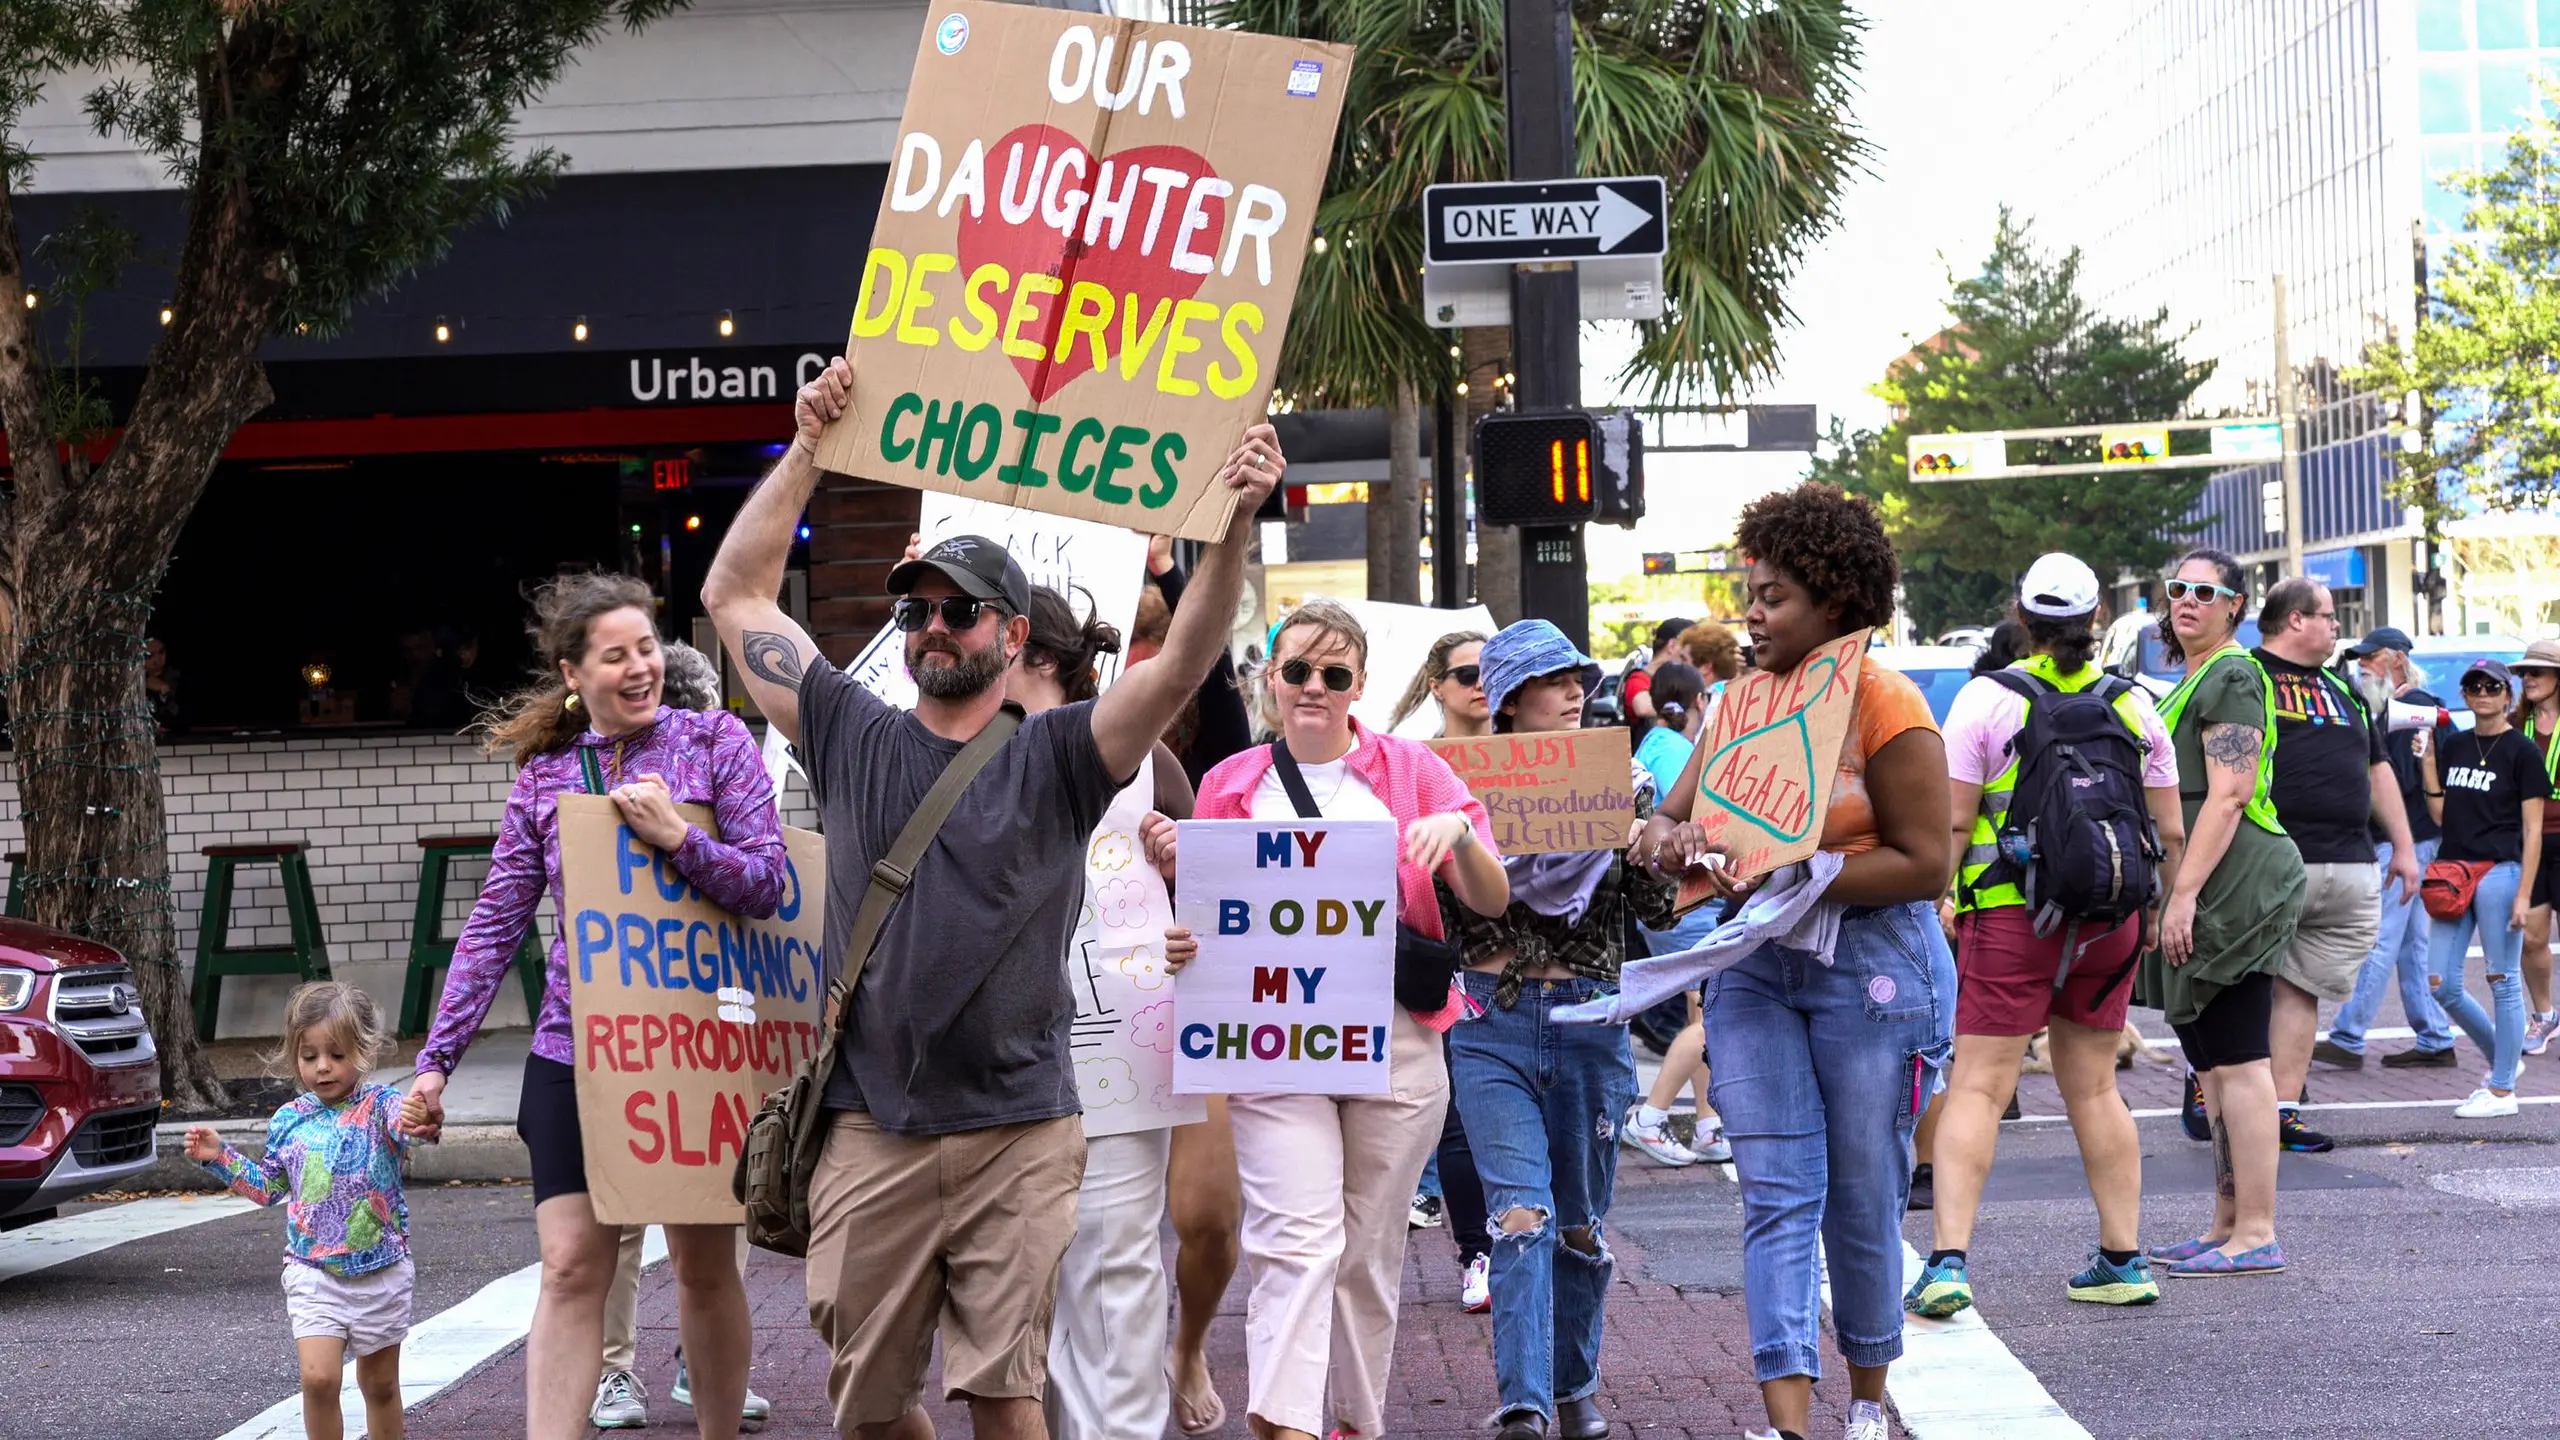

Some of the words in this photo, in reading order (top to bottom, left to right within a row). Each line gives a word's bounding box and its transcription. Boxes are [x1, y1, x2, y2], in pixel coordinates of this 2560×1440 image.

[1047, 24, 1191, 120] OUR
[890, 131, 1287, 286] DAUGHTER
[1453, 208, 1518, 238] ONE
[1531, 204, 1599, 235] WAY
[851, 248, 1264, 400] DESERVES
[630, 356, 777, 401] Urban
[879, 392, 1187, 509] CHOICES
[1551, 438, 1590, 502] 11
[653, 459, 689, 490] EXIT
[1713, 639, 1858, 752] NEVER
[1500, 733, 1590, 771] JUST
[1714, 745, 1812, 833] AGAIN
[1256, 831, 1327, 868] MY
[1491, 820, 1621, 849] IGHTS
[1218, 899, 1386, 936] BODY
[575, 909, 823, 1004] PREGNANCY
[1252, 966, 1327, 1004] MY
[1180, 1022, 1386, 1063] CHOICE!
